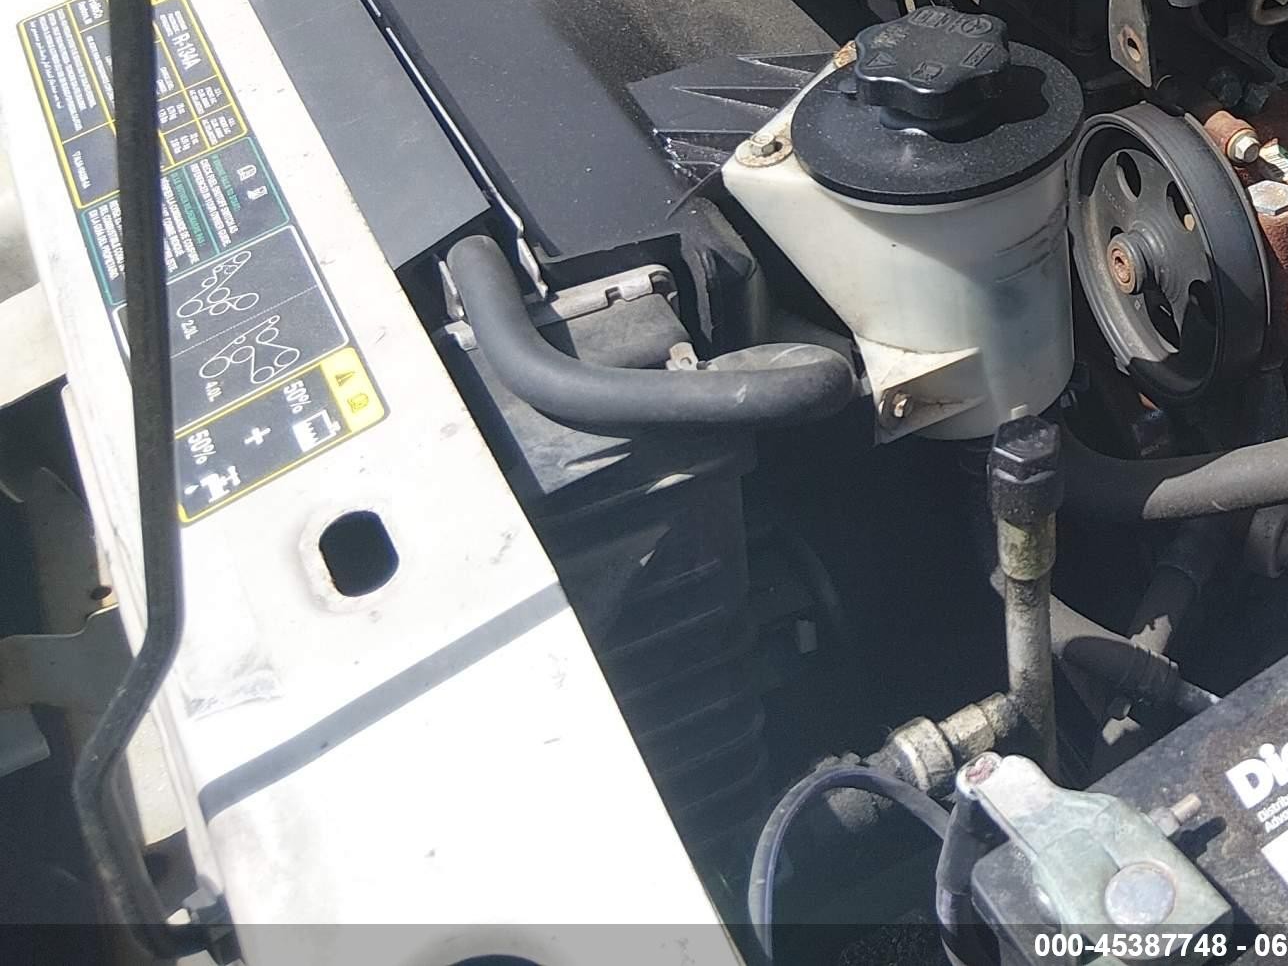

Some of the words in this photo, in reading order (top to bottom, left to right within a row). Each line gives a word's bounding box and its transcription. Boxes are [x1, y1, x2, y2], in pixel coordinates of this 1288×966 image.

[170, 30, 202, 70] R-134A
[199, 157, 214, 176] CHECK
[283, 379, 312, 414] 50%
[187, 428, 217, 465] 50%
